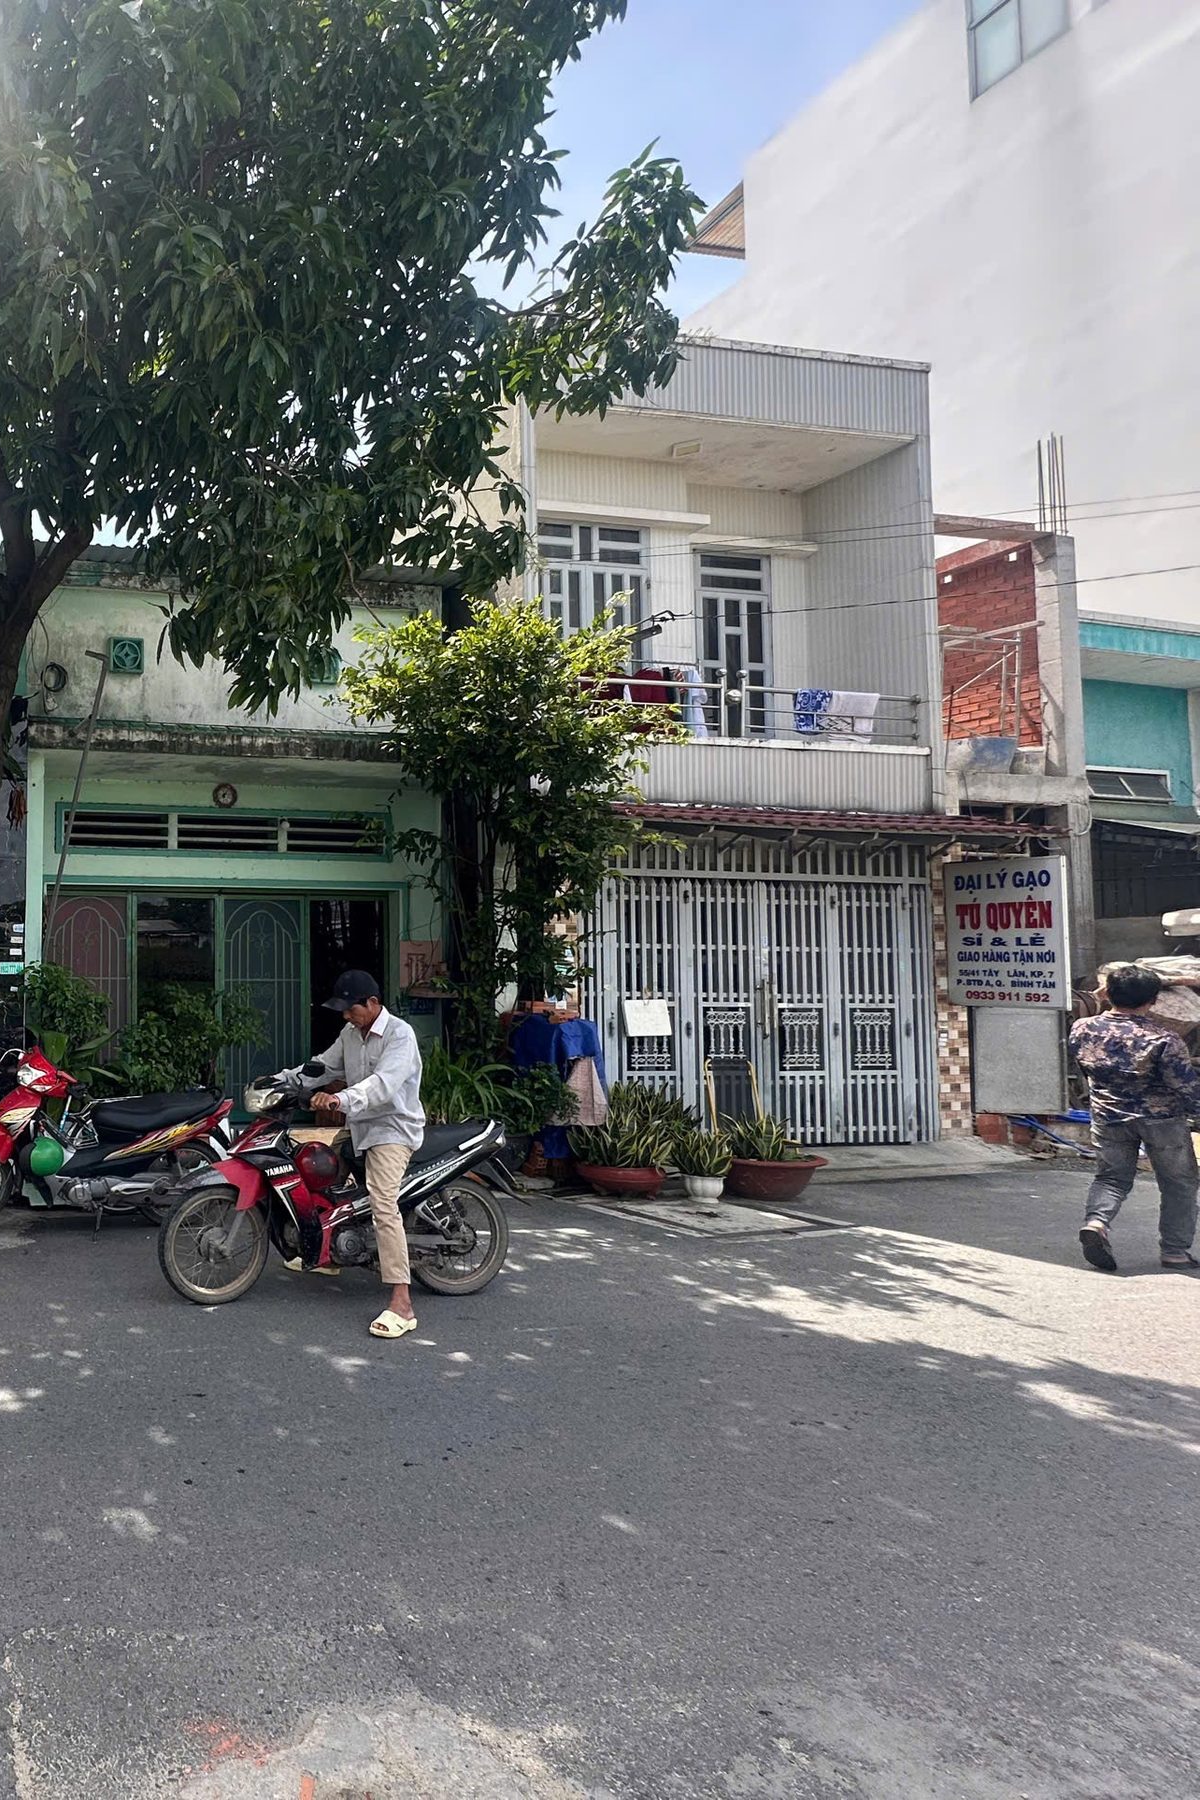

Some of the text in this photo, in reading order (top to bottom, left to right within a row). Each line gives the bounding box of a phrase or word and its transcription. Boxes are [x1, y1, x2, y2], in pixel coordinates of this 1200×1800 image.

[954, 868, 1051, 895] ĐẠI LÝ GẠO
[956, 895, 1053, 933] TÚ QUYÊN
[990, 937, 1008, 947] &
[957, 949, 1056, 965] GIAO HÀNG TẬN NƠI
[959, 969, 980, 977] 55/41
[982, 968, 1000, 978] TÂY
[1030, 970, 1046, 978] KP.
[1011, 979, 1034, 989] BÌNH
[1035, 979, 1056, 989] TÂN
[966, 990, 1050, 1003] 0933 911 592
[264, 1163, 295, 1177] YAMAHA
